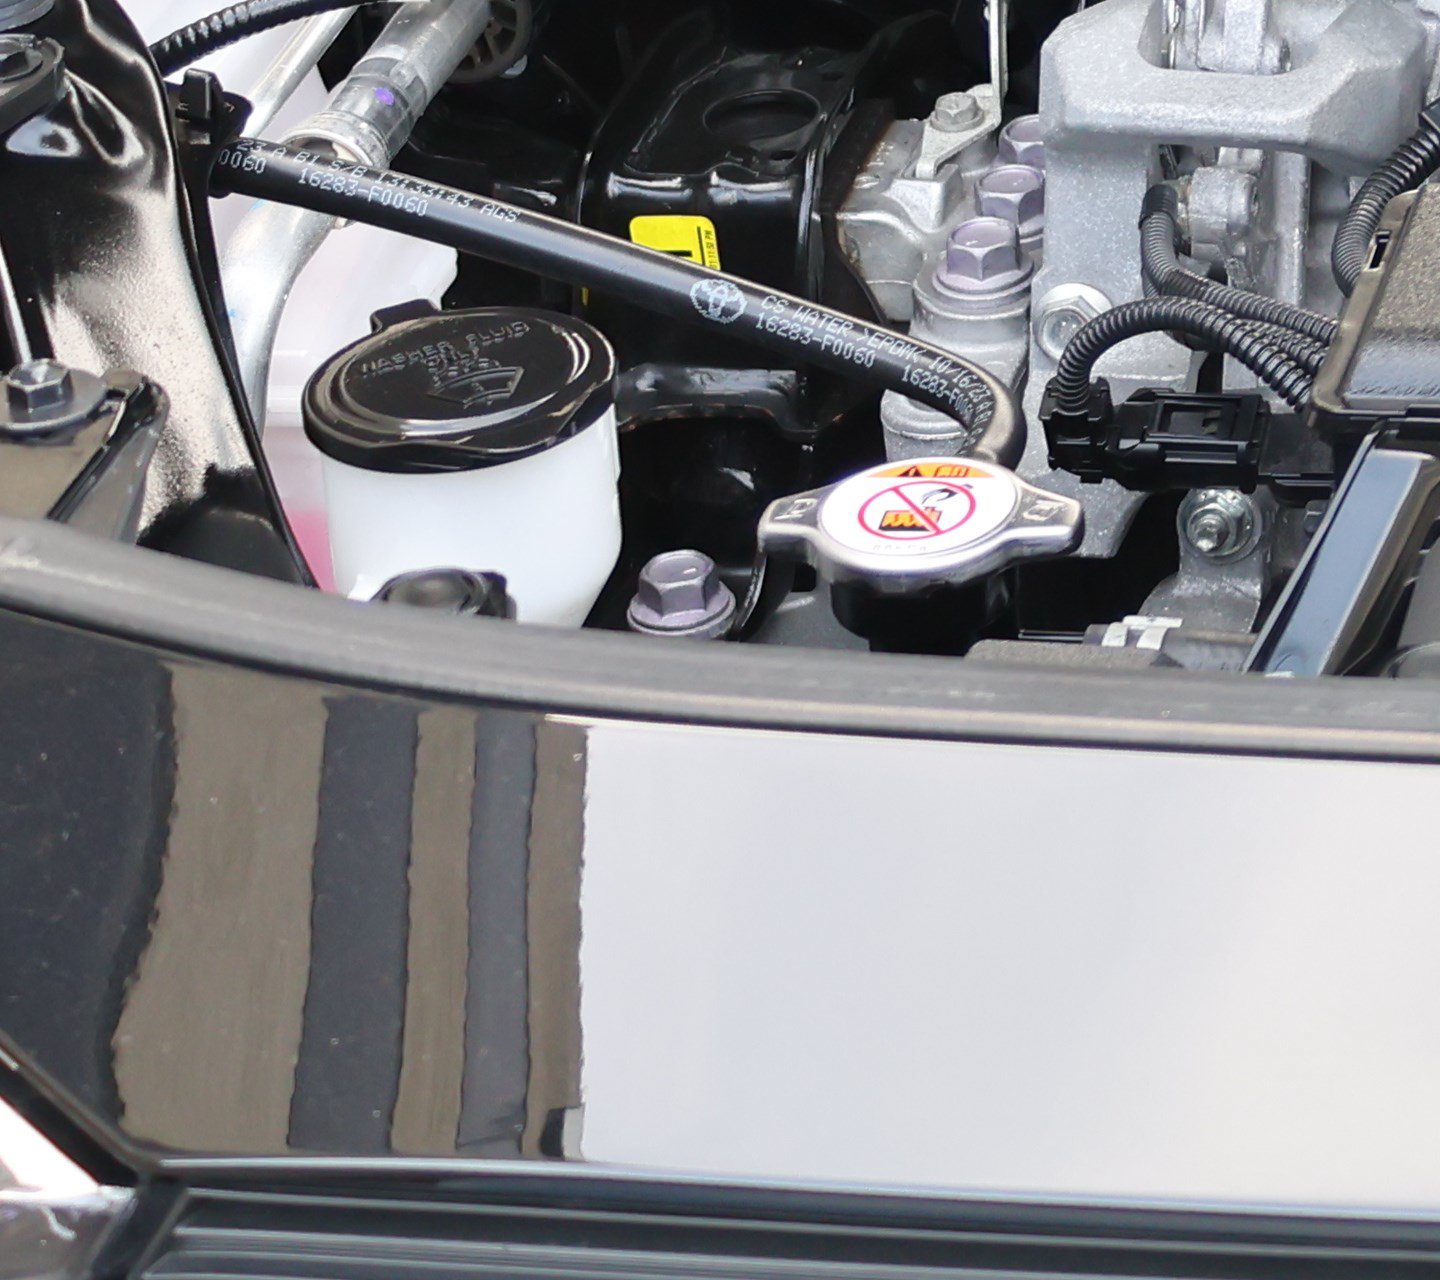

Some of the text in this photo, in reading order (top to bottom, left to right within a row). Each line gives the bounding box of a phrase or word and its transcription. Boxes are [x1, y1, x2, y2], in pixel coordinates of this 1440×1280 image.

[298, 167, 429, 217] 16283-F0060
[360, 321, 531, 377] WASHER FLUID
[755, 311, 876, 369] 16283-F0060
[761, 295, 787, 313] CS
[792, 302, 854, 337] WATER
[929, 356, 992, 403] 10/16/23
